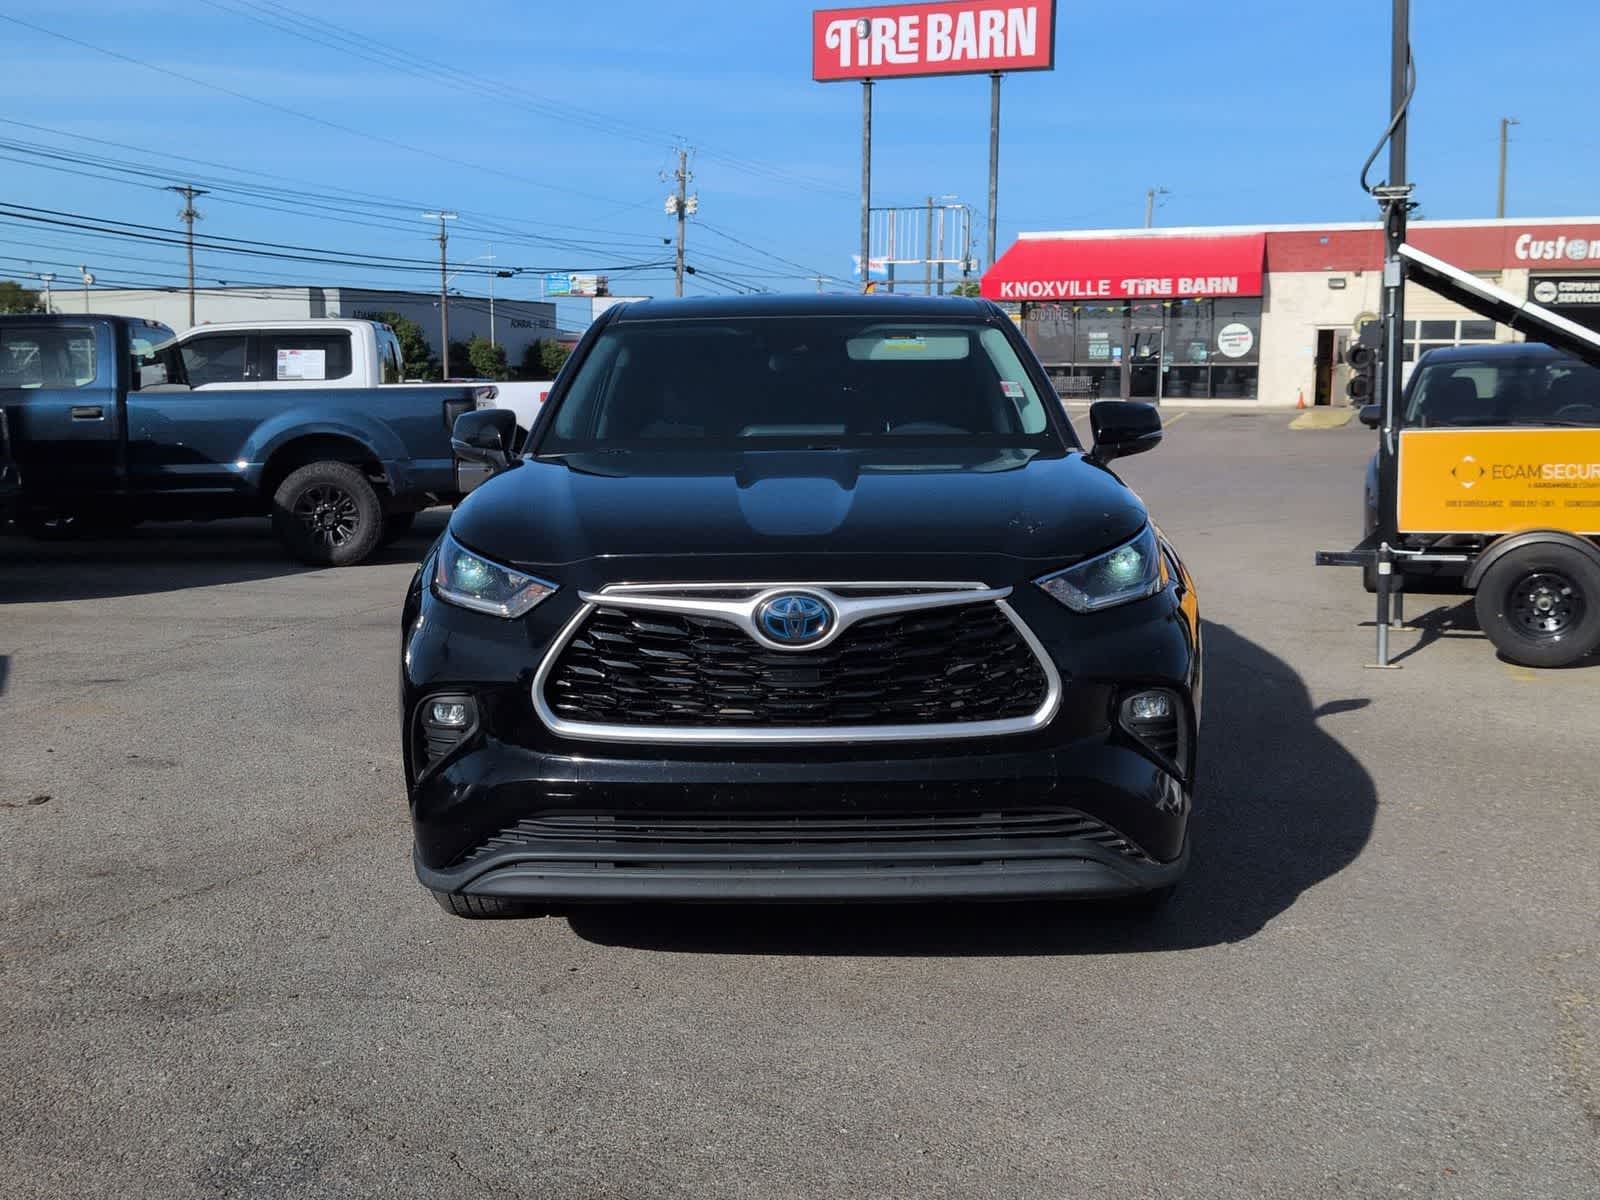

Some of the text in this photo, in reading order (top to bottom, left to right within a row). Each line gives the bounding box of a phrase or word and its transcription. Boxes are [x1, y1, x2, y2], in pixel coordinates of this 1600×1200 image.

[926, 7, 1037, 62] BARN
[1000, 279, 1111, 298] KNOXVILLE
[1177, 276, 1238, 294] BARN
